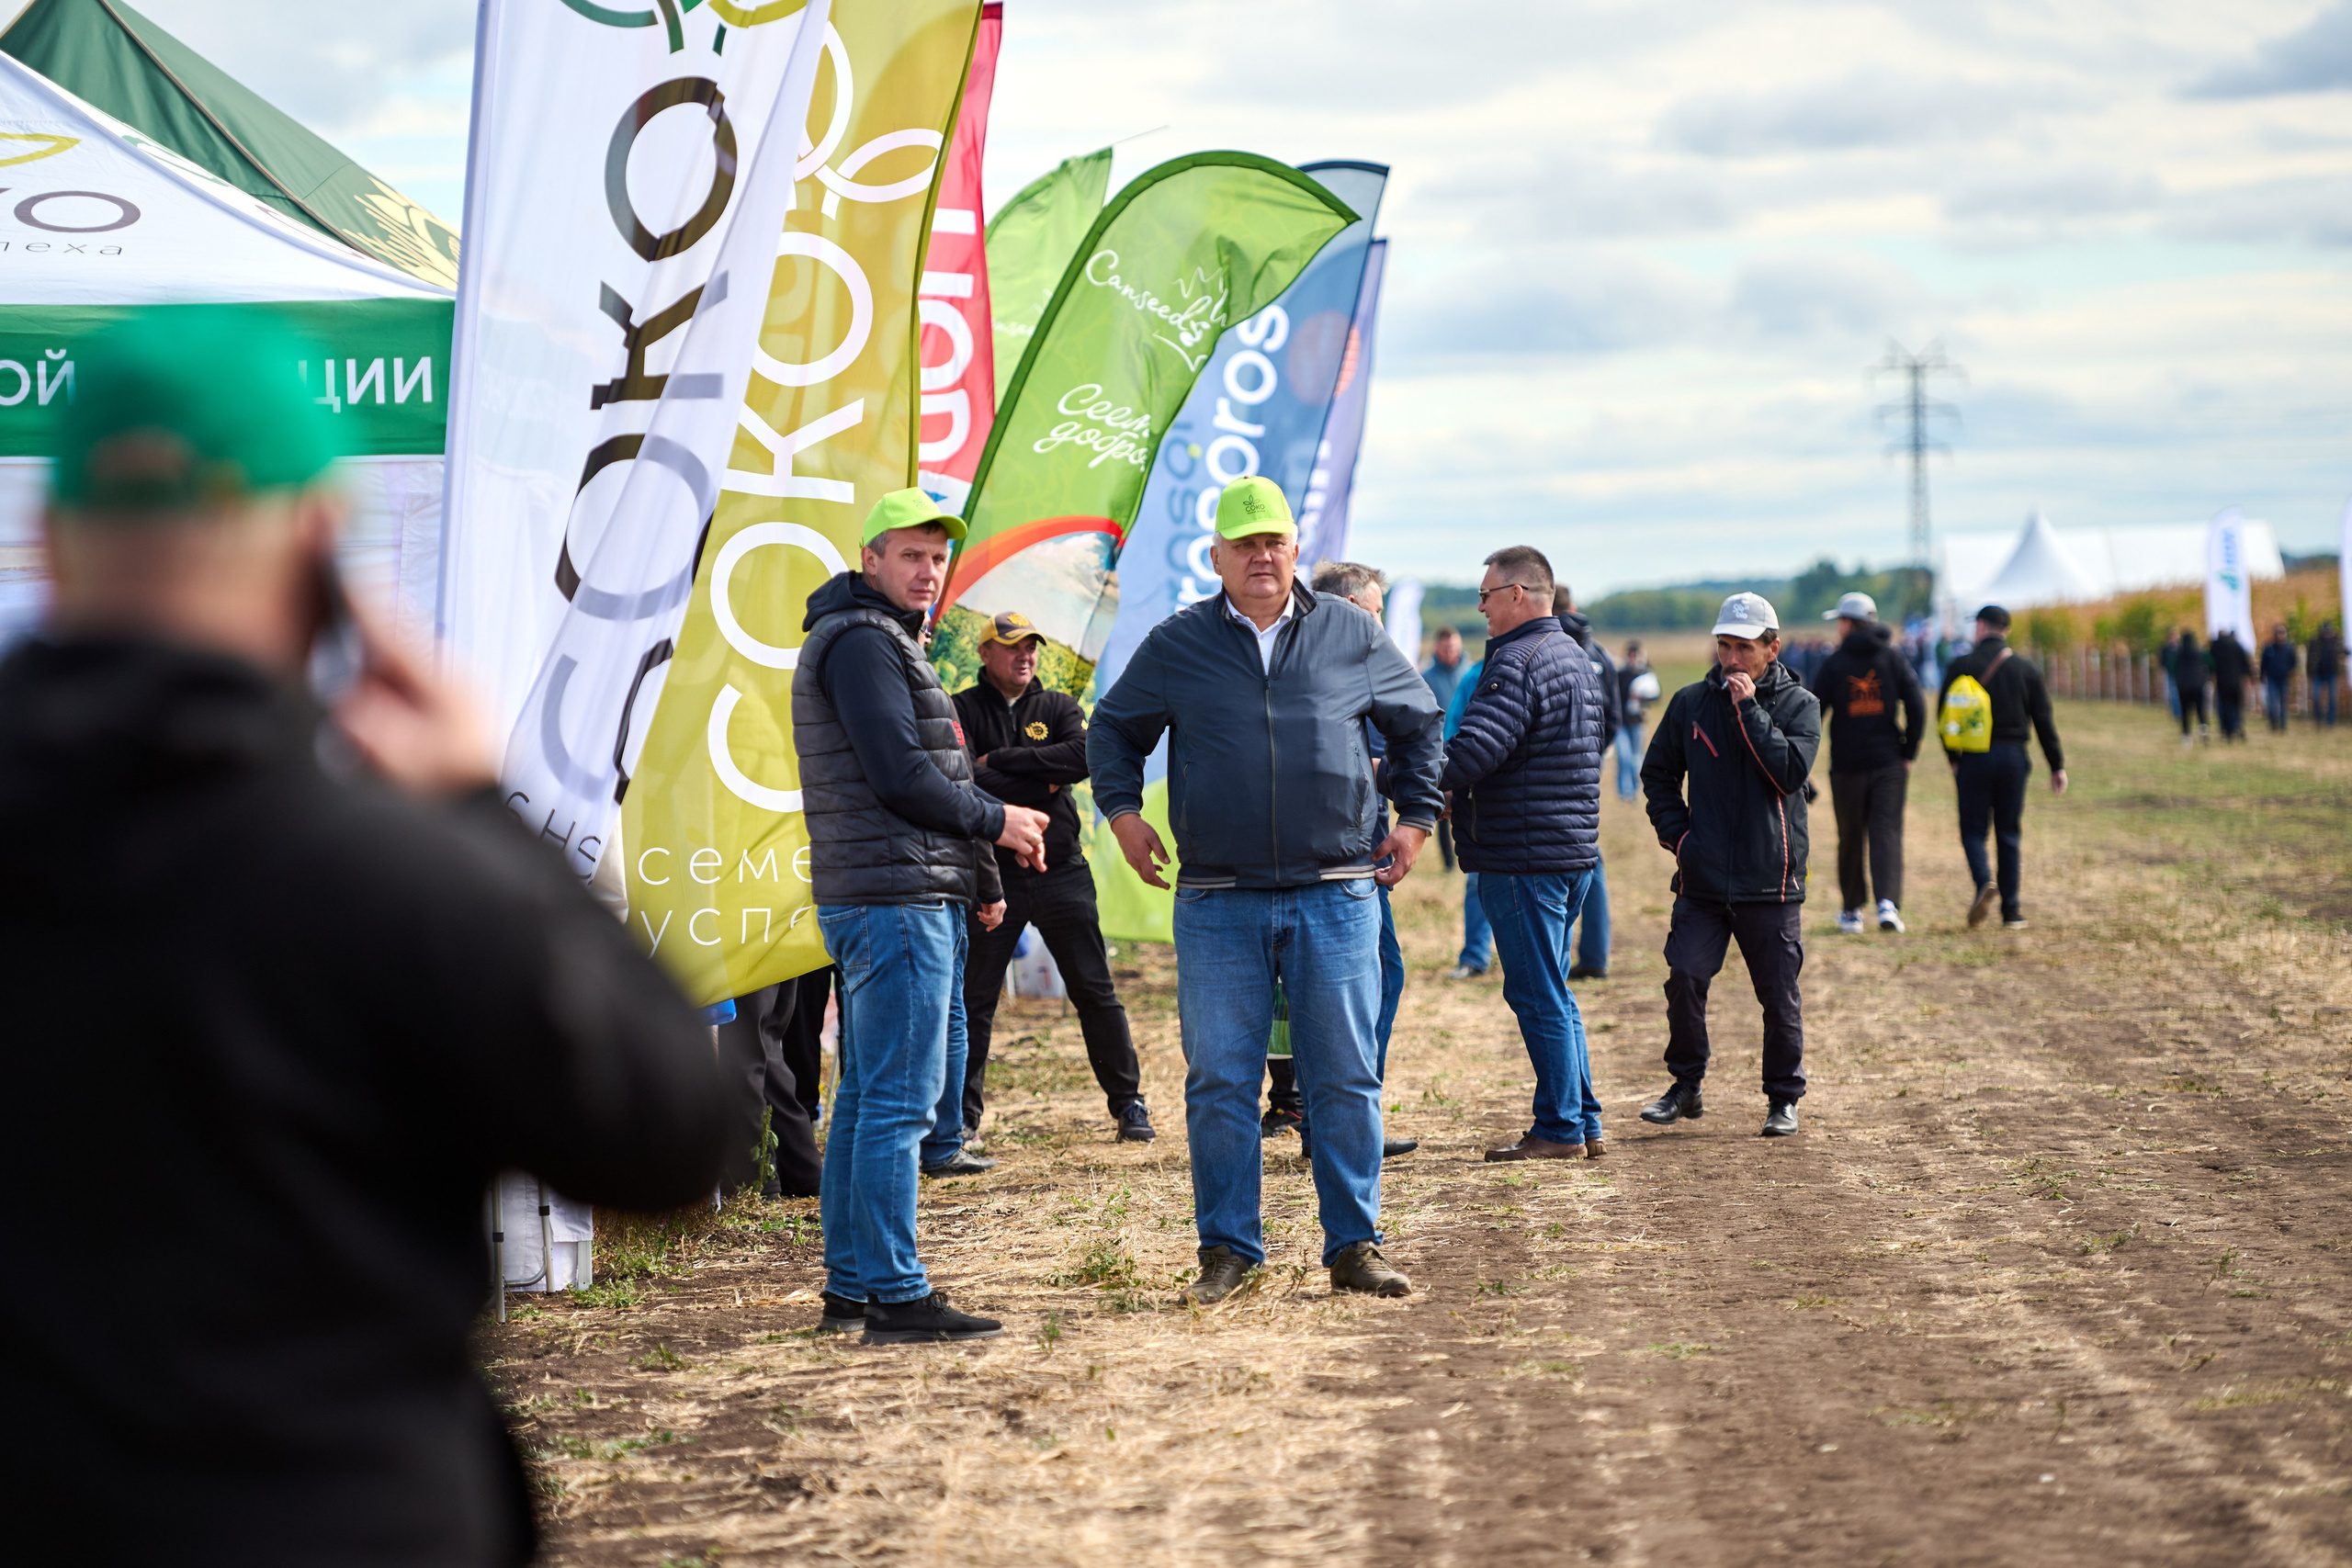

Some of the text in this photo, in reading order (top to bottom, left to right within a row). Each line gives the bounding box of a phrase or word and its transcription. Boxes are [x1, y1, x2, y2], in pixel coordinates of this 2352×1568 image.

[707, 231, 874, 813] СОКО
[1173, 304, 1290, 614] rosoros
[638, 846, 813, 886] семе
